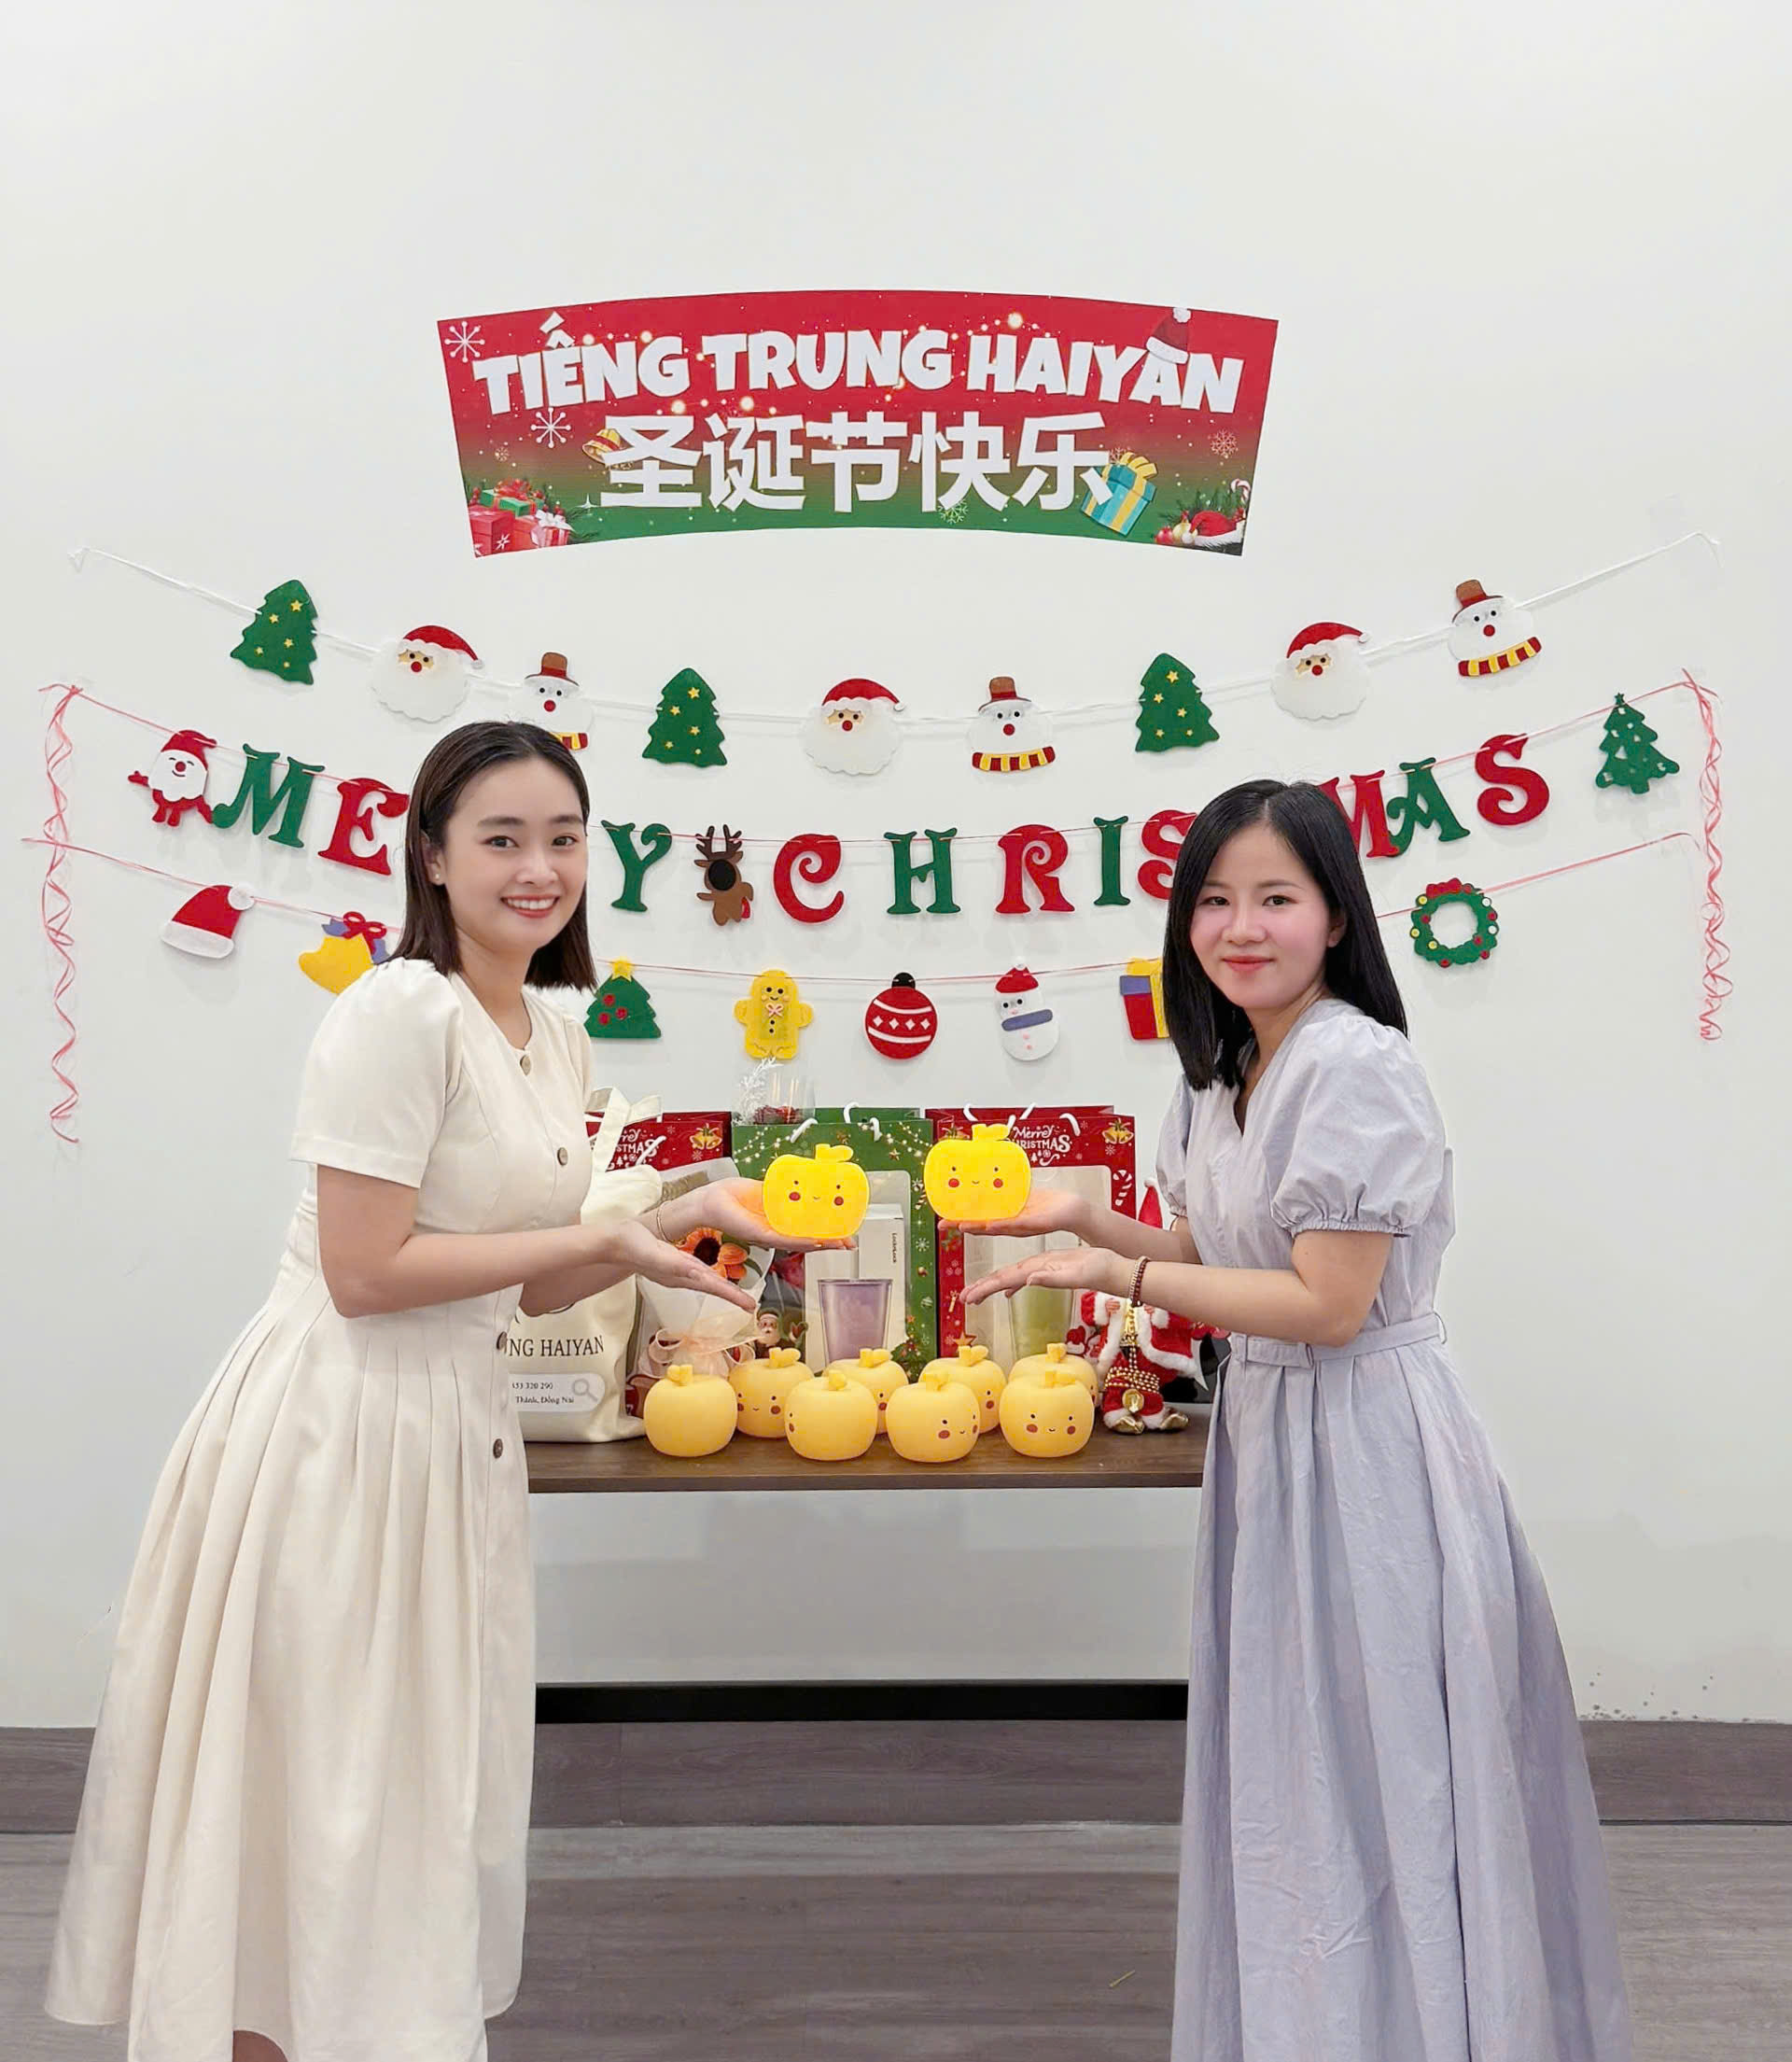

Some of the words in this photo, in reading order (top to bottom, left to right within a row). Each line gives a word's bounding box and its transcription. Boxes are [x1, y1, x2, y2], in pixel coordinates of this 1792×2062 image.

[472, 311, 691, 415] TIẾNG
[701, 329, 952, 391] TRUNG
[599, 411, 1114, 512] 圣诞节快乐
[509, 1338, 535, 1357] NG
[540, 1335, 605, 1357] HAIYAN
